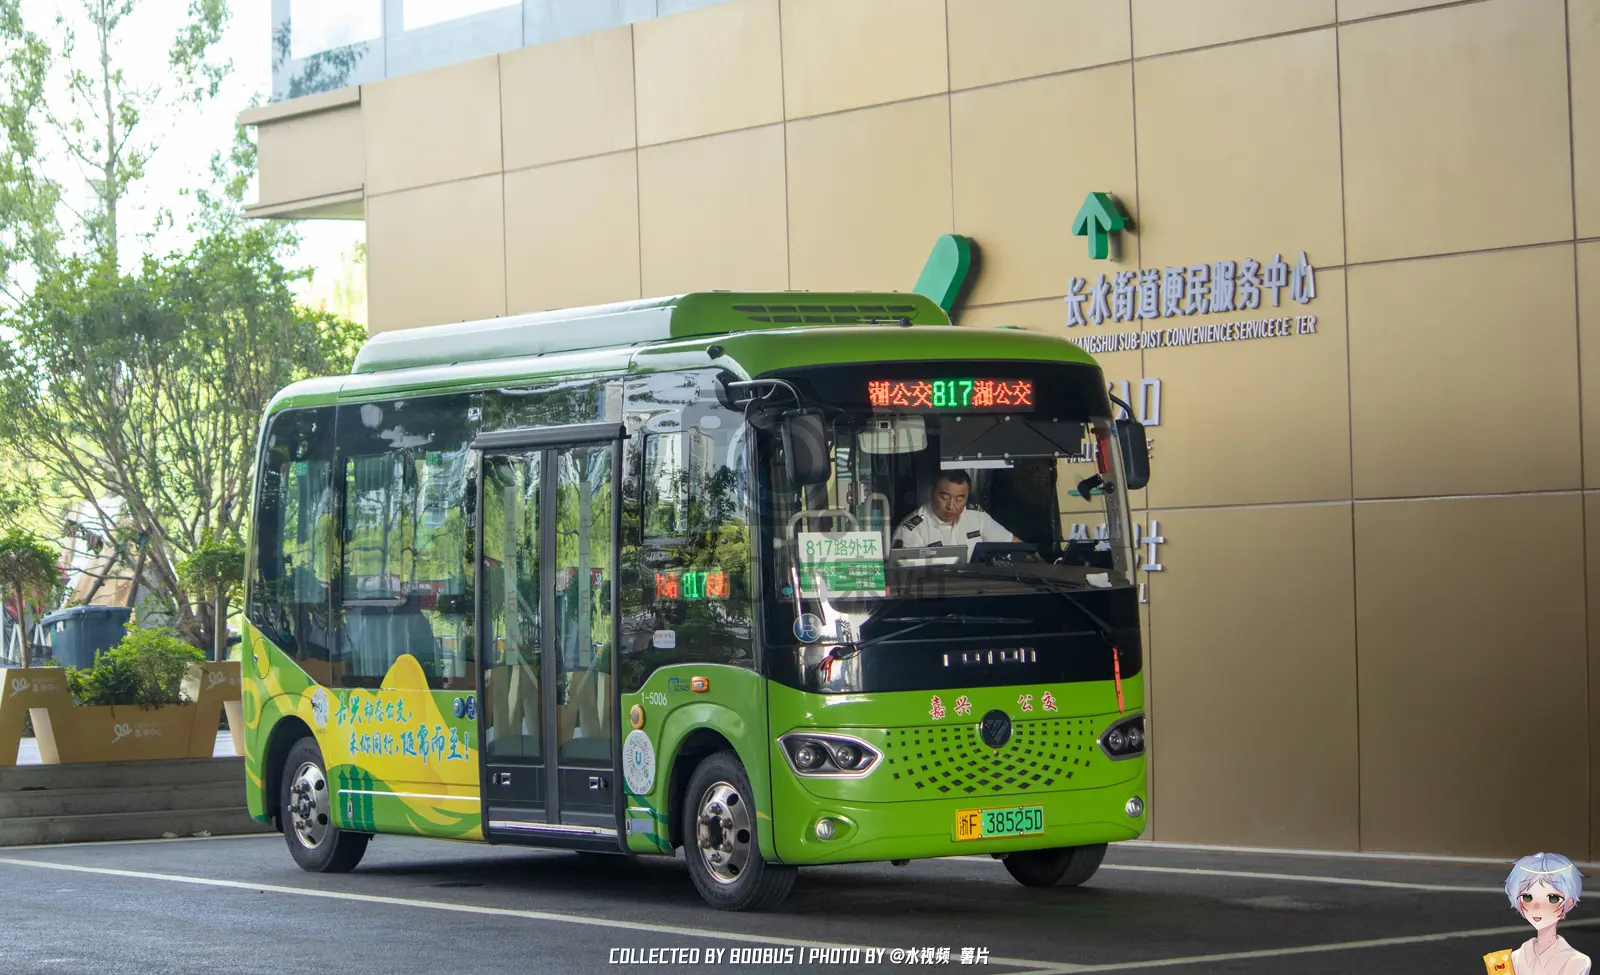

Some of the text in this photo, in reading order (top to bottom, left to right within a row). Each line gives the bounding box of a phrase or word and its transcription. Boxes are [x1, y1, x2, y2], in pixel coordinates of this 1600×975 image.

[1064, 251, 1316, 327] 长水街道便民服务中心
[1166, 322, 1235, 346] CONVENIENCE
[1234, 318, 1276, 341] SERVICE
[806, 538, 877, 556] 817路外环
[682, 571, 706, 598] 817
[641, 692, 668, 706] 1-5006
[929, 690, 1058, 720] 嘉兴 公交
[986, 809, 1043, 834] 38525D
